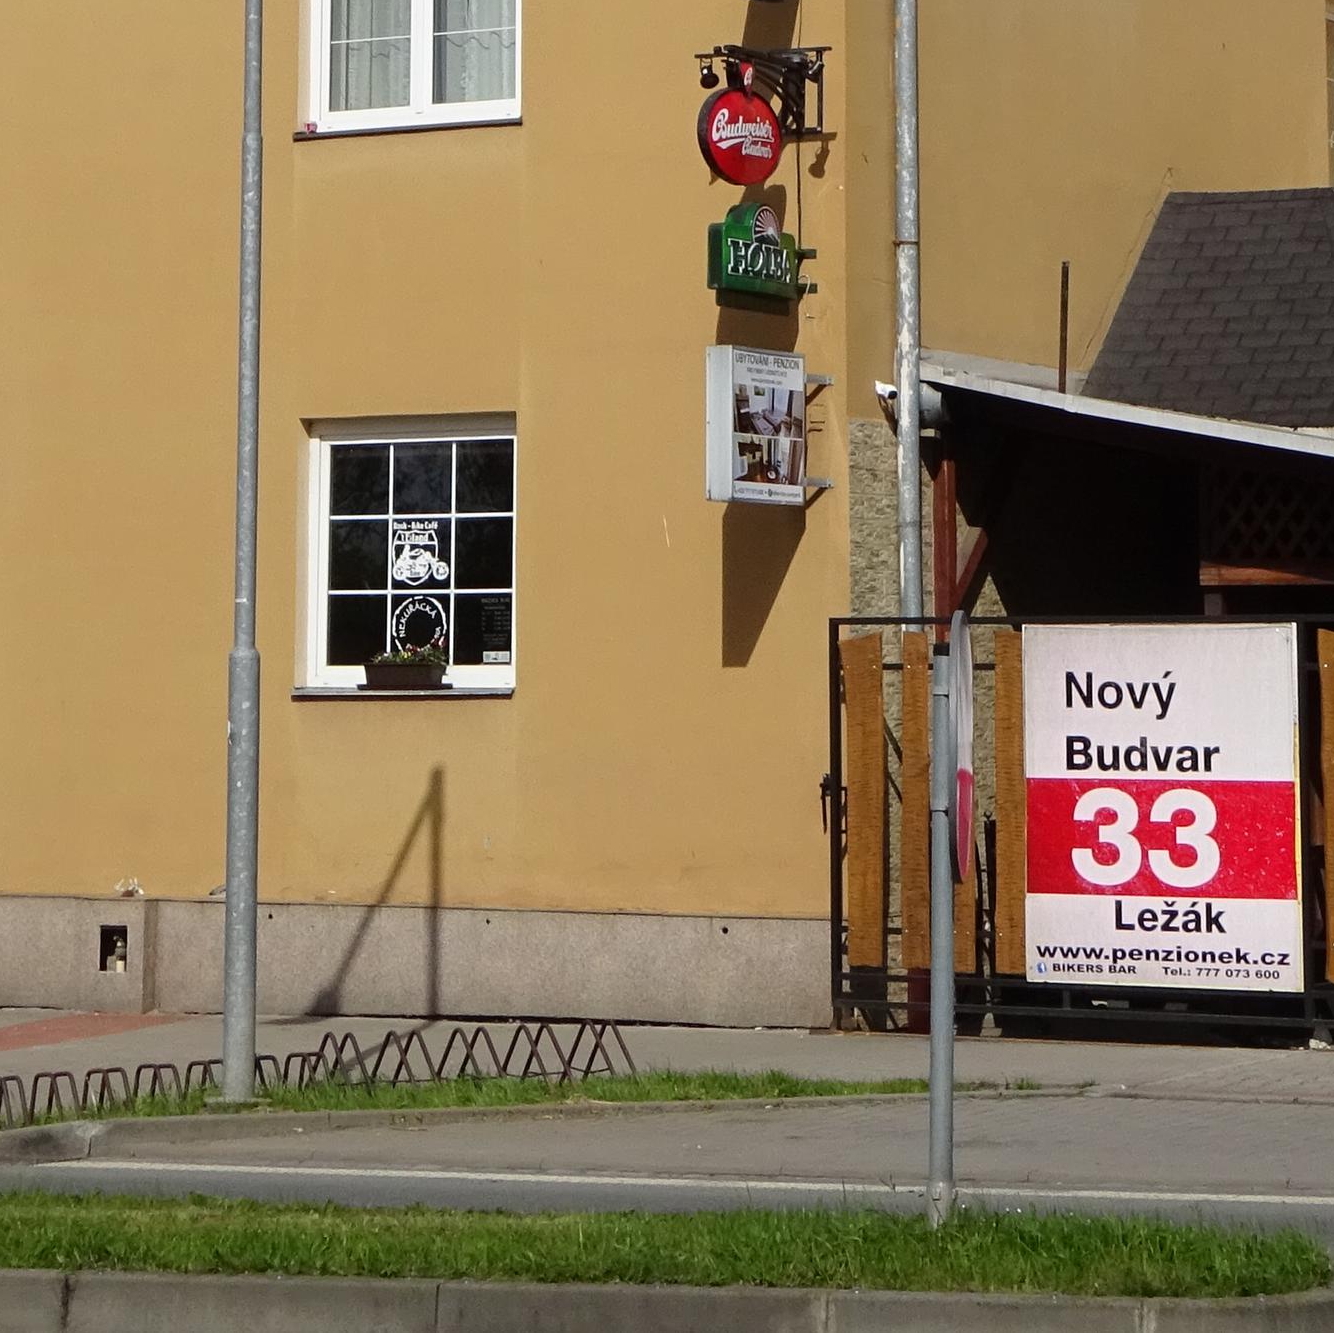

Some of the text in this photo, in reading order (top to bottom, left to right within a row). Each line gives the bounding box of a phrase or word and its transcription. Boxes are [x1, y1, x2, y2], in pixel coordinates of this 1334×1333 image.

[712, 108, 774, 143] Budweiser
[728, 238, 791, 283] HOLBA
[773, 357, 800, 370] PENZION
[1065, 670, 1176, 720] Nový
[1065, 735, 1220, 772] Budvar
[1071, 787, 1221, 889] 33
[1115, 899, 1226, 934] Ležák
[1036, 945, 1291, 966] www.penzionek.cz
[1052, 963, 1280, 980] BIKERS BAR Tel.: 777 073 600
